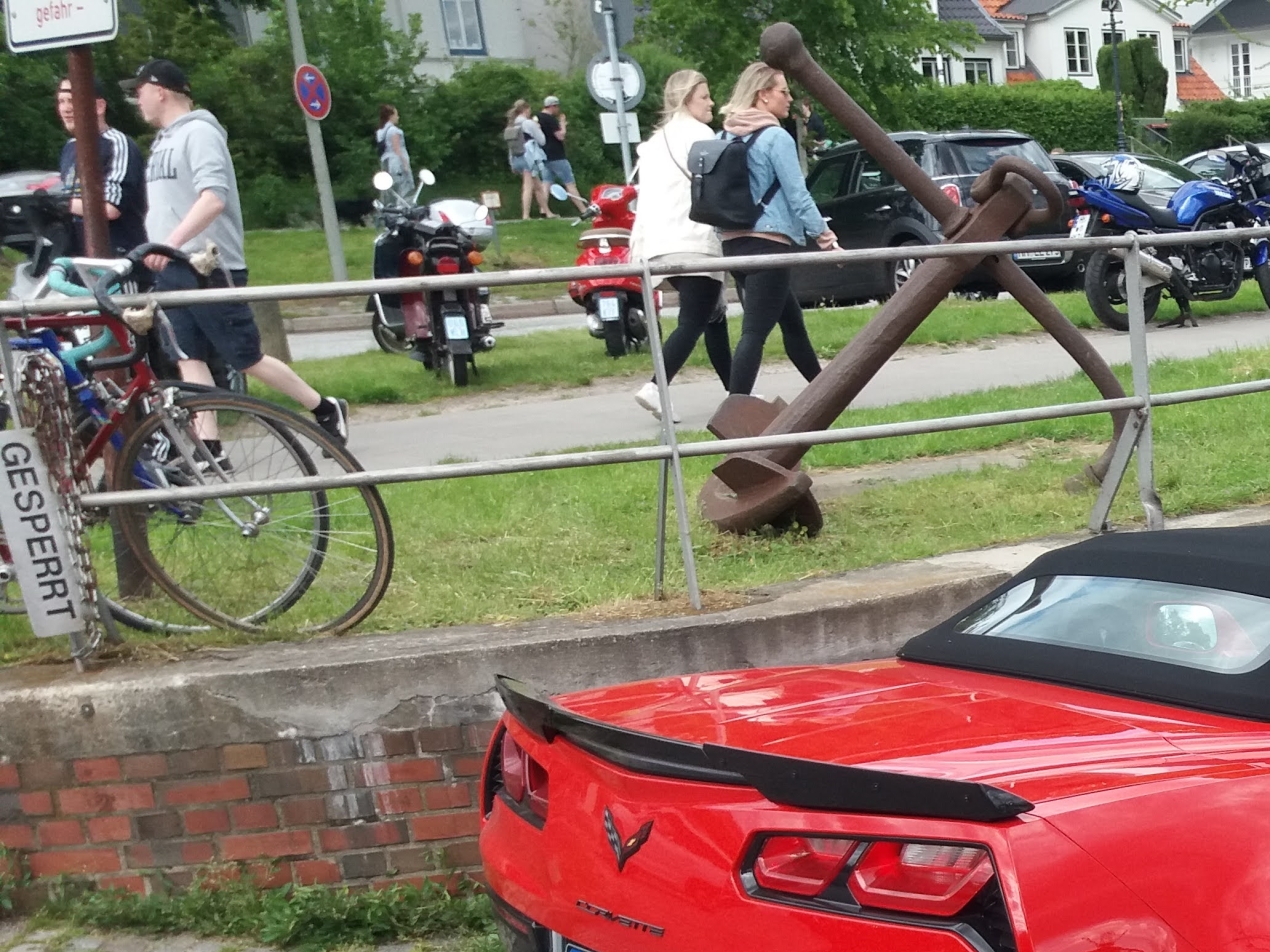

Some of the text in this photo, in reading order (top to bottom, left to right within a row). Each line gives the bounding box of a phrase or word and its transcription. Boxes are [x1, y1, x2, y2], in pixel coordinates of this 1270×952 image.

[36, 1, 72, 28] gefahr
[1, 442, 76, 619] GESPERRT
[576, 899, 665, 937] CORVETTE
